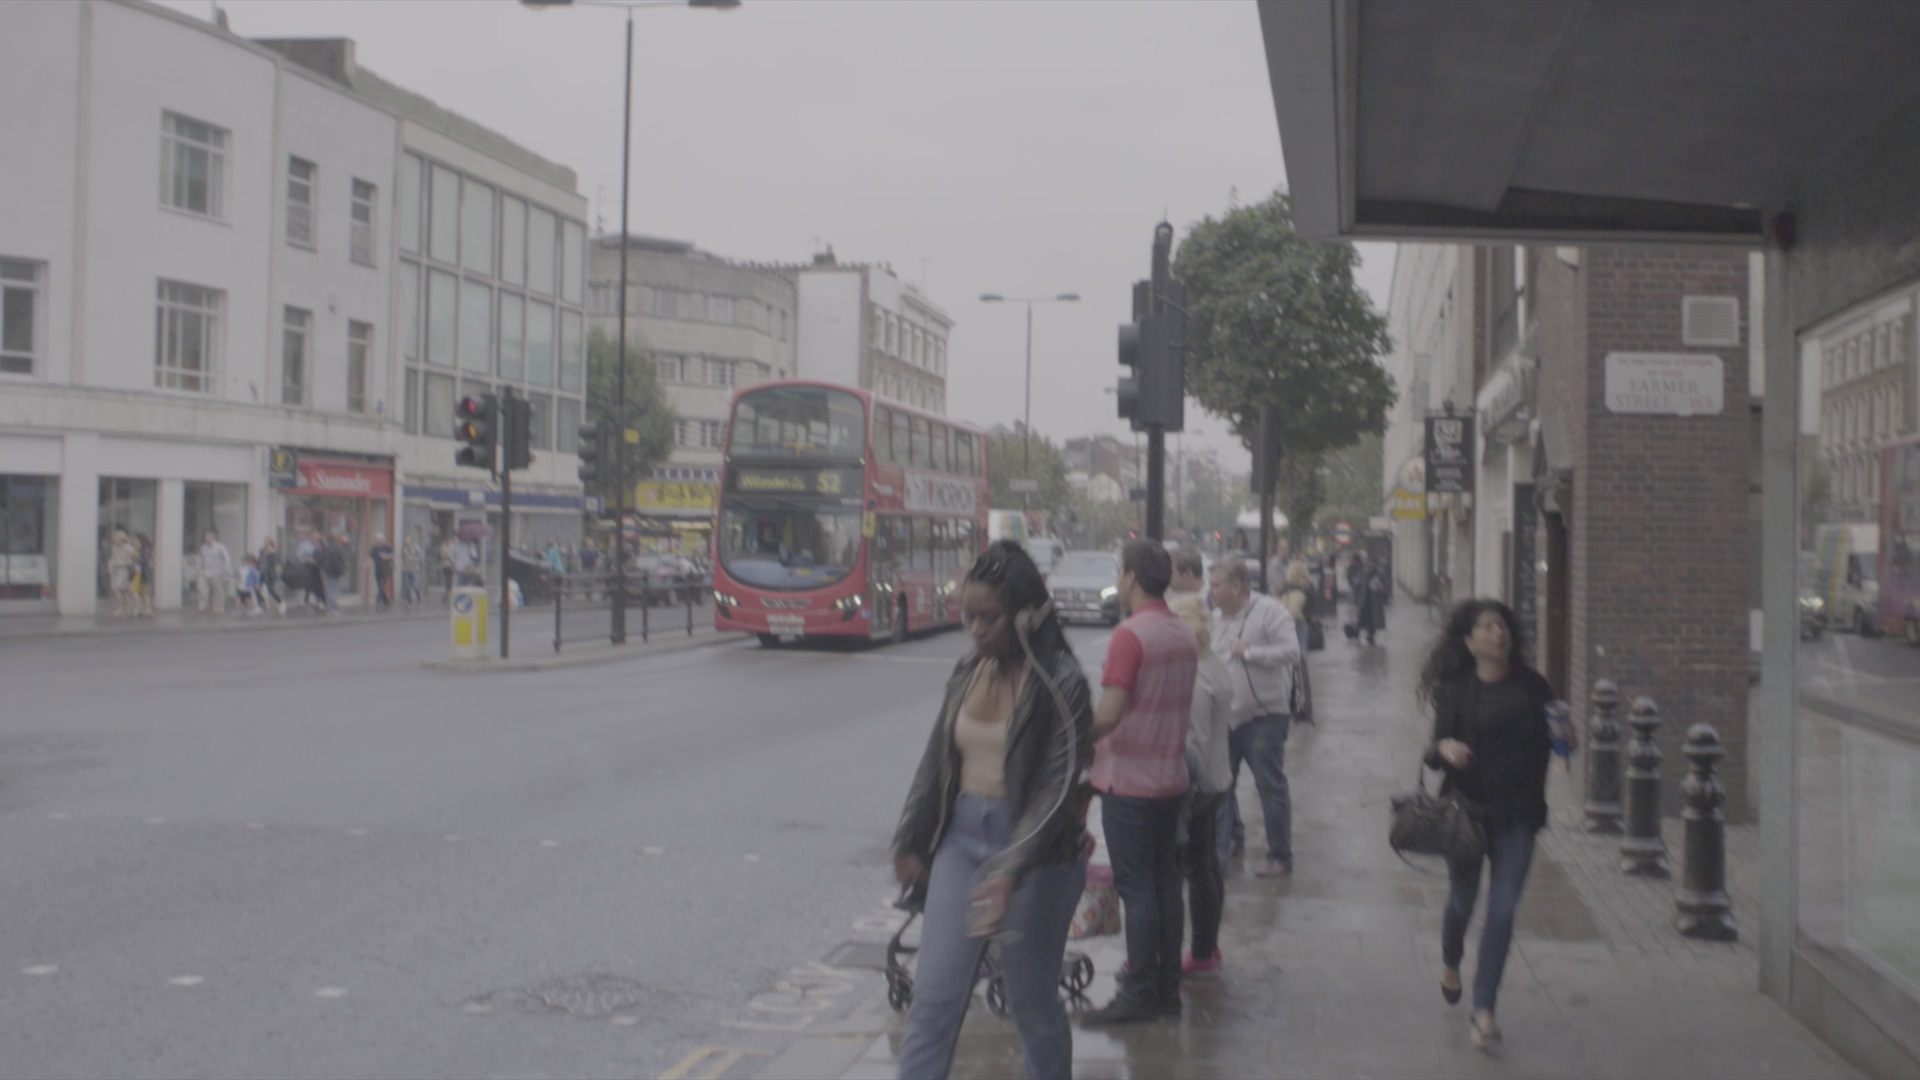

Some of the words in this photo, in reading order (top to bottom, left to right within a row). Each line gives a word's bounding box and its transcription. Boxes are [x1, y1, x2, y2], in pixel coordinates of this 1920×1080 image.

[1630, 379, 1698, 394] FARMER
[1616, 394, 1671, 409] STREET
[313, 469, 371, 492] Santander
